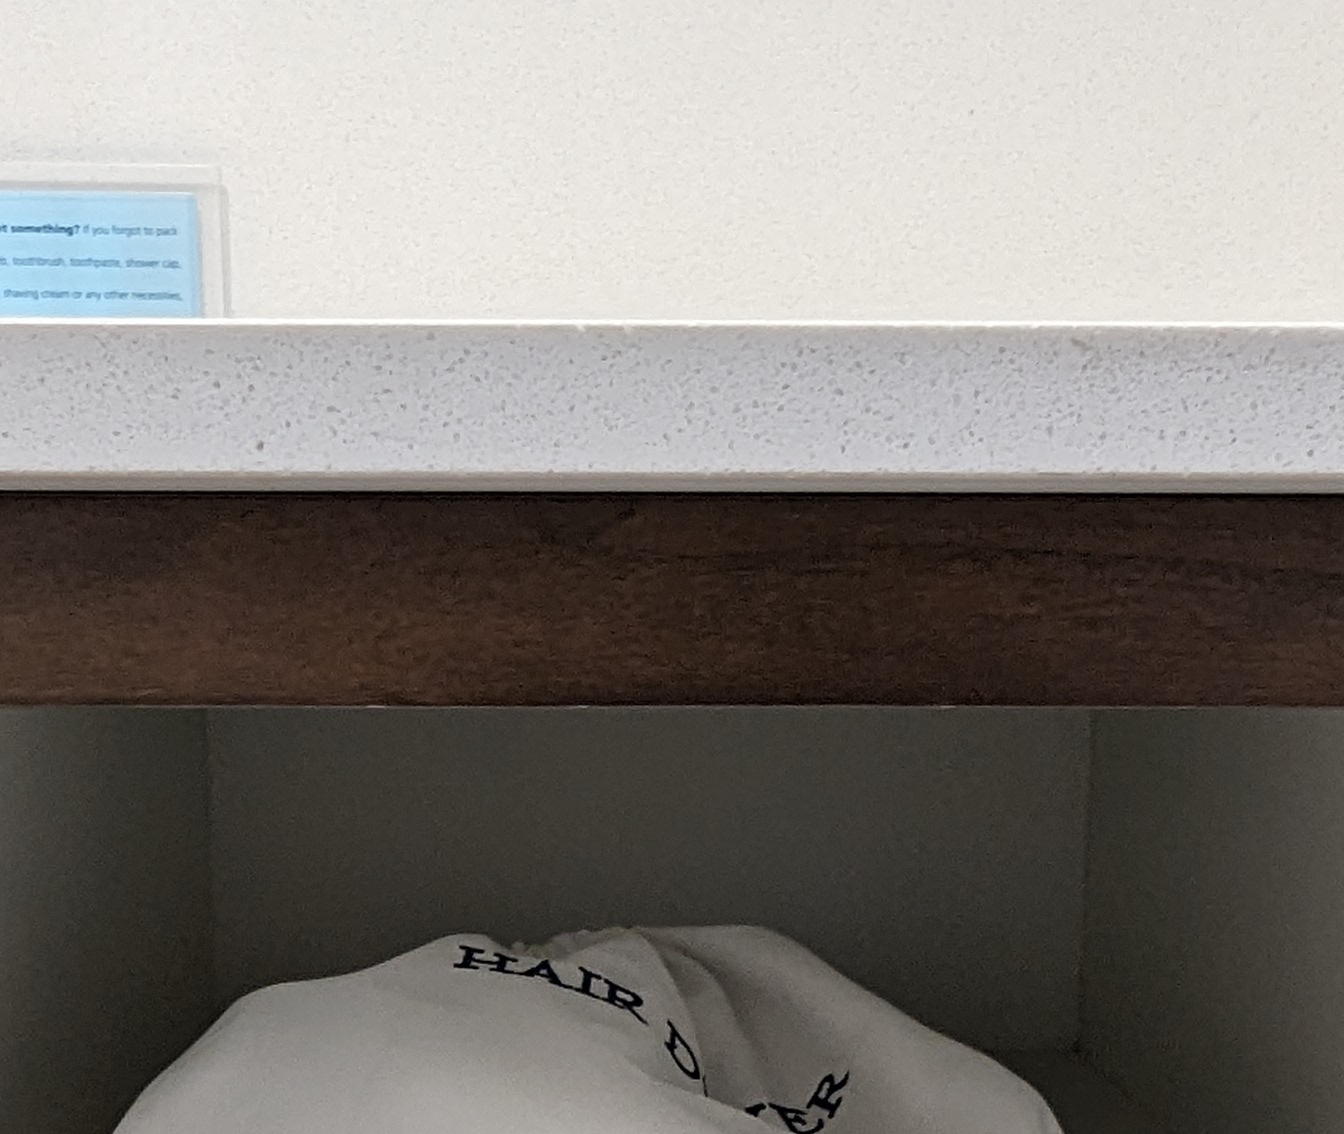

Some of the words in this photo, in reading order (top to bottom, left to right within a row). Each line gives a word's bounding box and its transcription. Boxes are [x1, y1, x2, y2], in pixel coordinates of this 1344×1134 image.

[92, 227, 110, 237] you
[125, 258, 159, 268] shower
[454, 945, 649, 1026] HAIR
